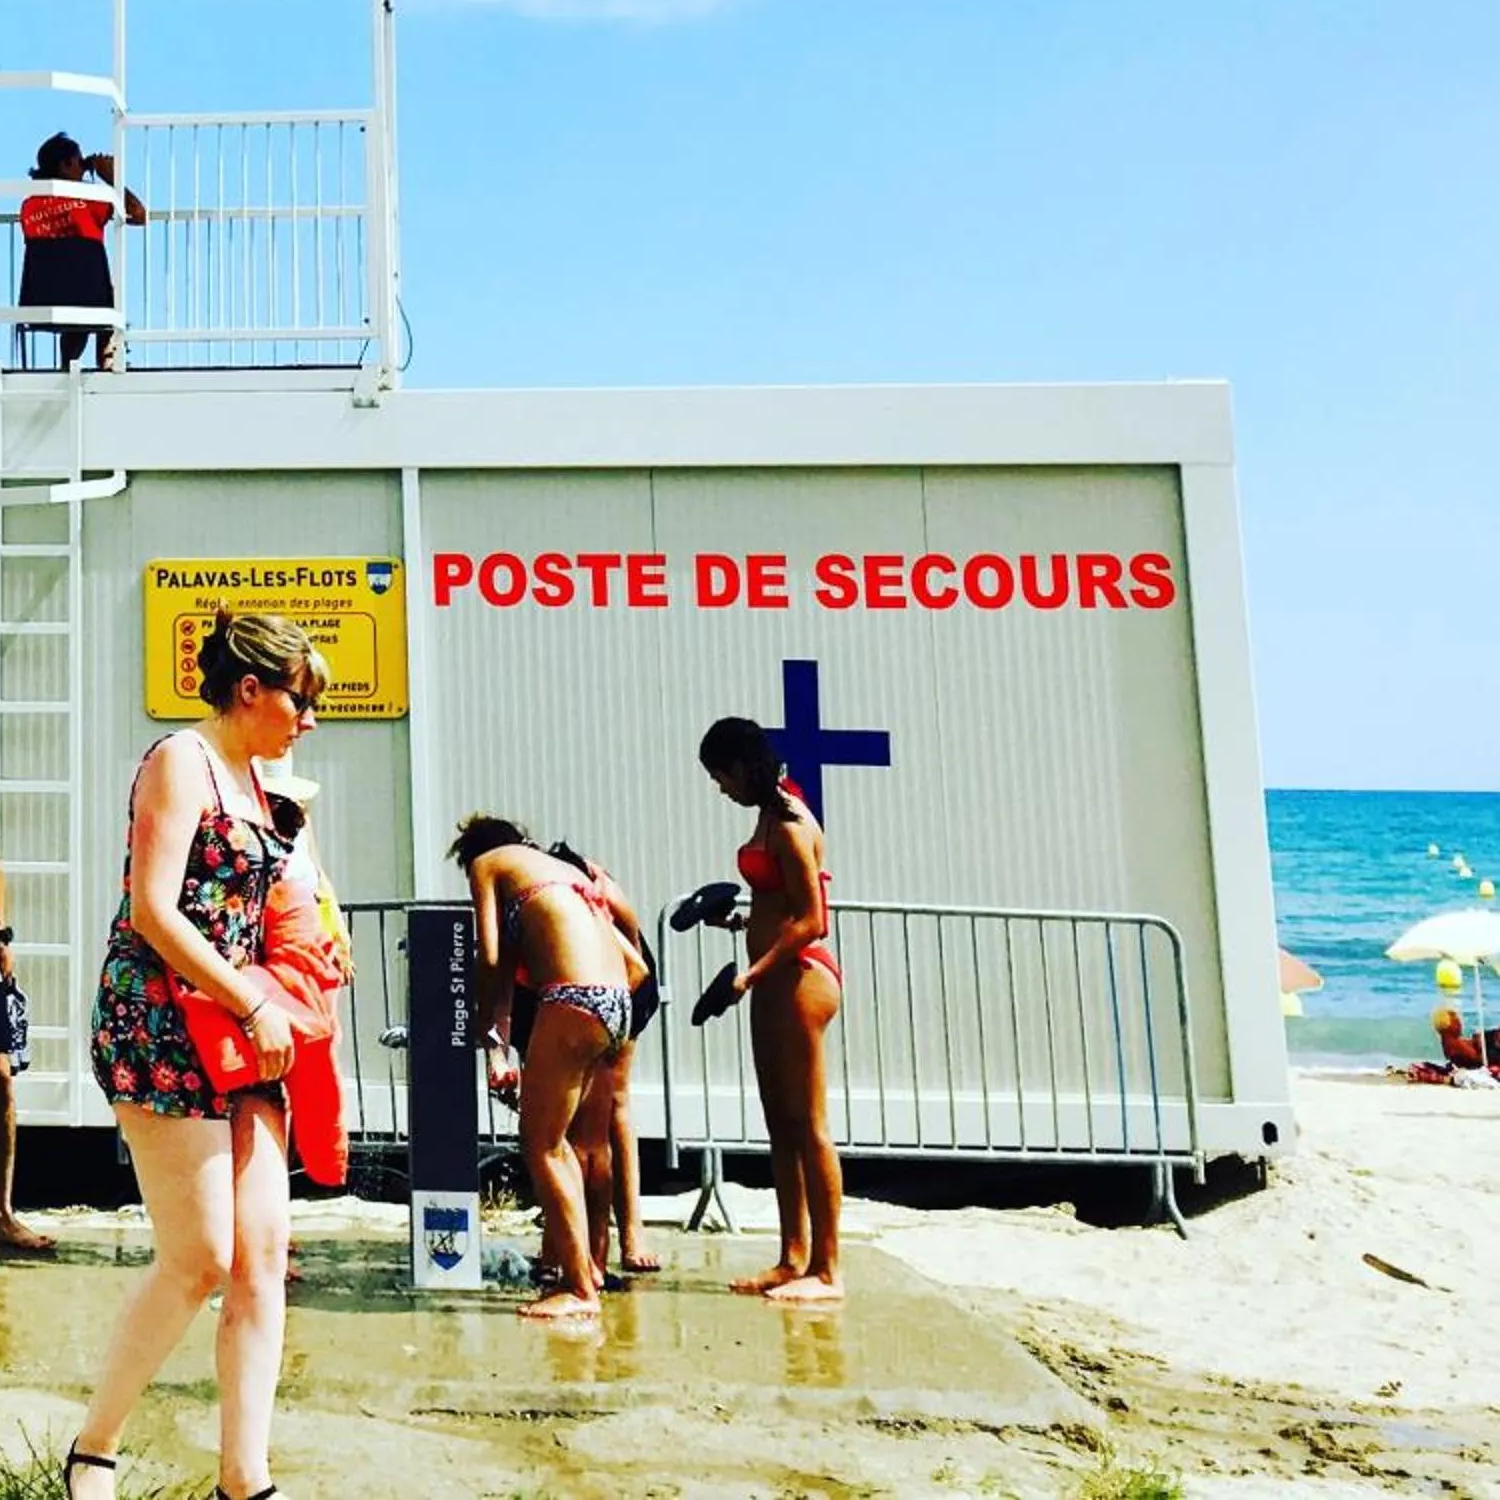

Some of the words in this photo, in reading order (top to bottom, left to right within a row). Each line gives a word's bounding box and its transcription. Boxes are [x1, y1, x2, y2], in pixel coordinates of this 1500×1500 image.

[156, 566, 358, 589] PALAVAS-LES-FLOTS
[433, 553, 669, 607] POSTE
[695, 554, 788, 609] DE
[815, 553, 1177, 610] SECOURS
[290, 597, 309, 608] des
[313, 597, 353, 610] plages
[310, 619, 340, 628] PLAGE
[449, 921, 465, 972] Pierre
[449, 977, 465, 994] St
[451, 999, 469, 1046] Plage
